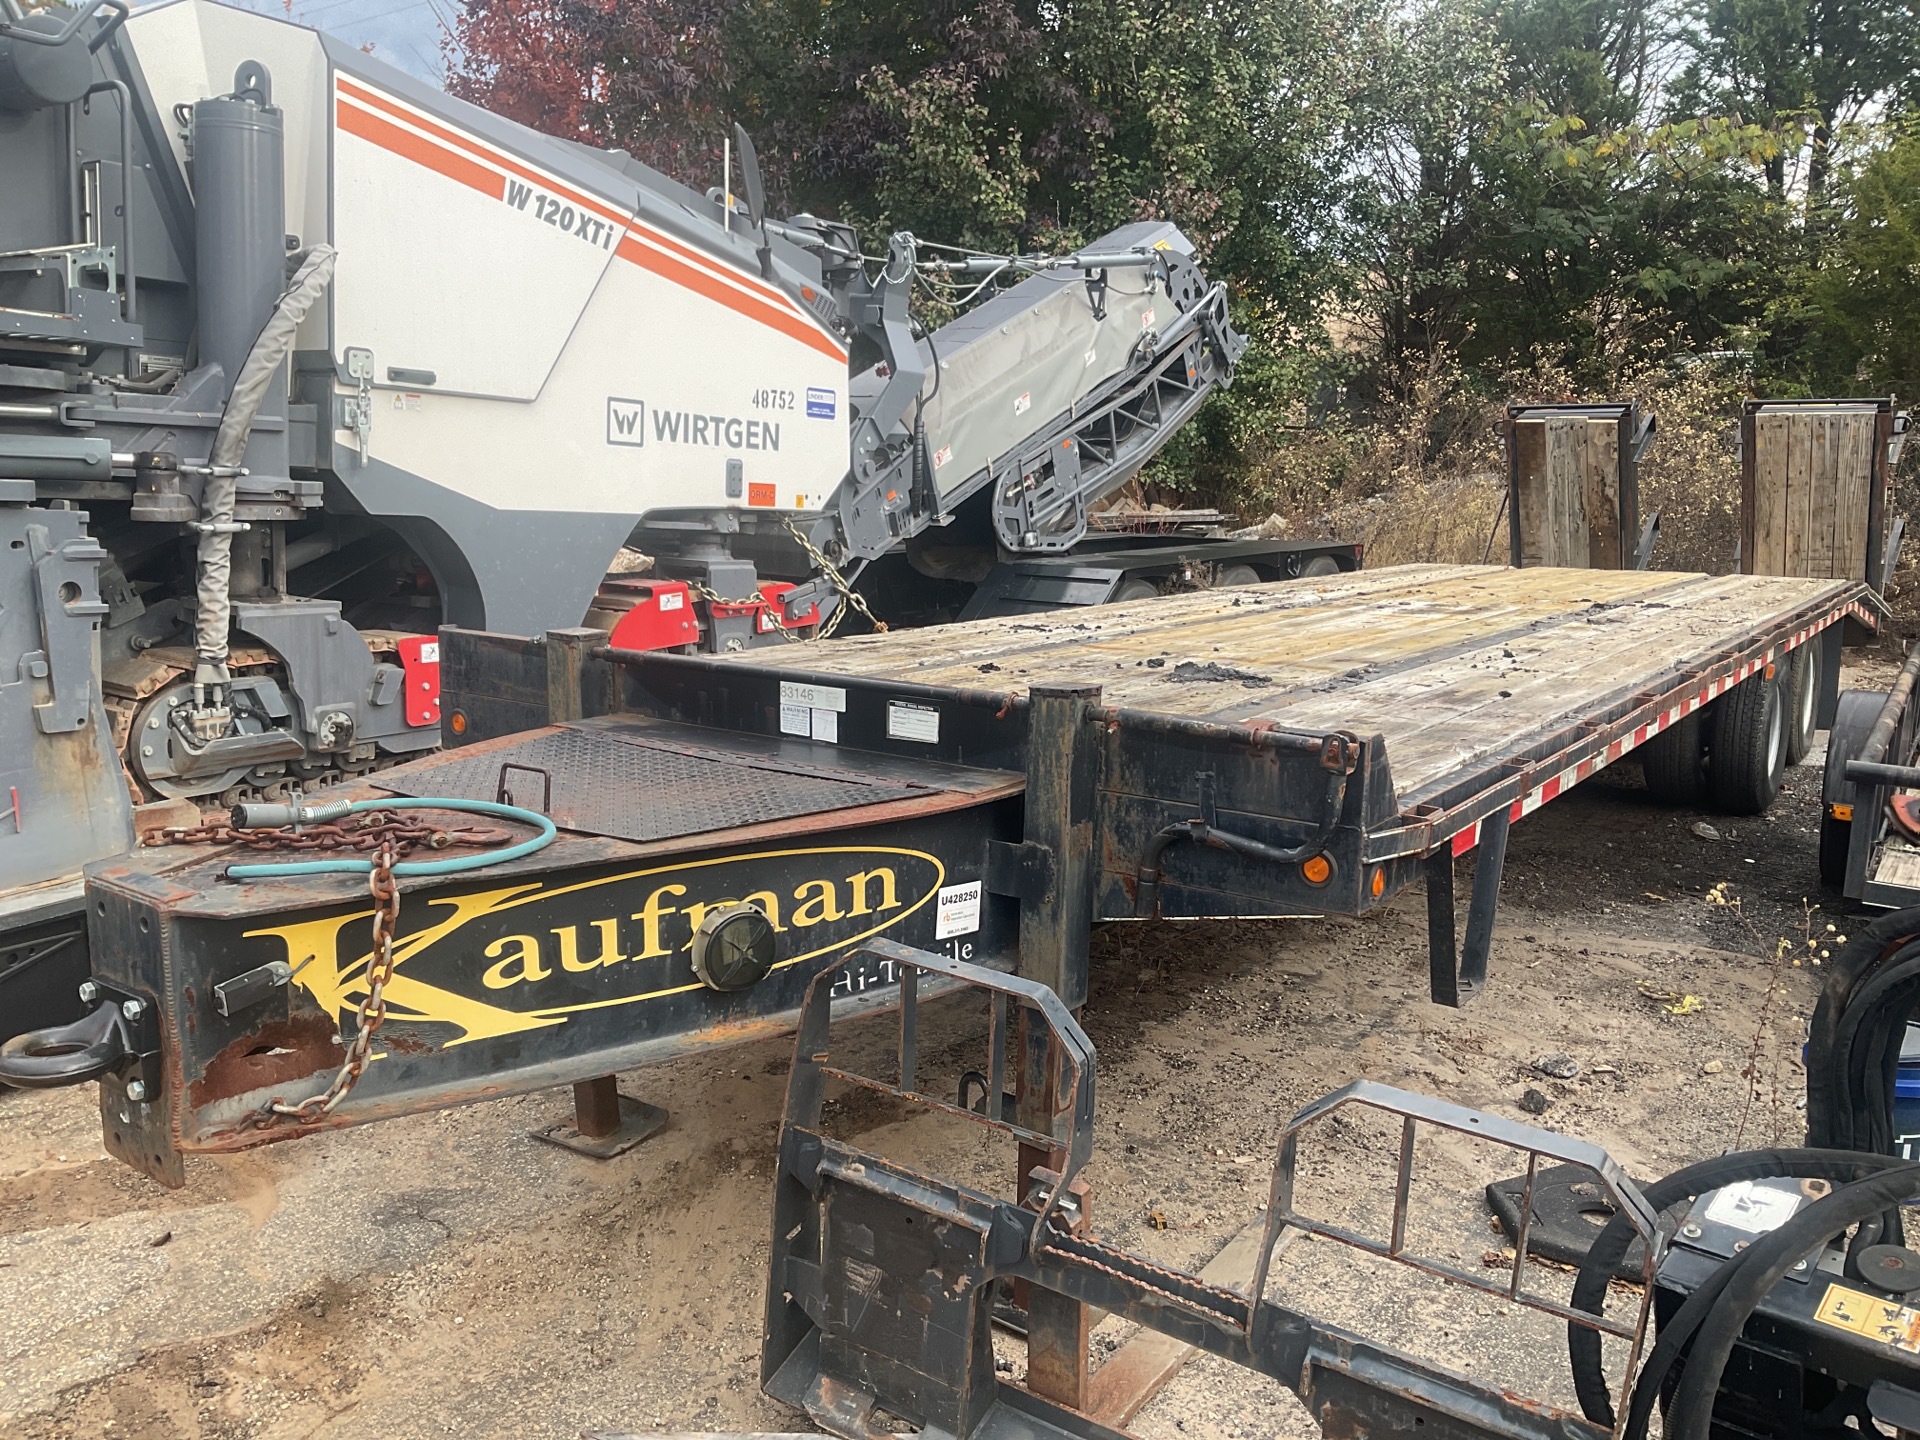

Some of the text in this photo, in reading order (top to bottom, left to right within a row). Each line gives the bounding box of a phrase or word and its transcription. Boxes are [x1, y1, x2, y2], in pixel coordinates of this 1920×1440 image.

[507, 179, 614, 251] W 120 XTi
[752, 389, 795, 410] 48752
[652, 409, 780, 452] WIRTGEN
[781, 686, 814, 701] 83146
[941, 890, 978, 905] U428250
